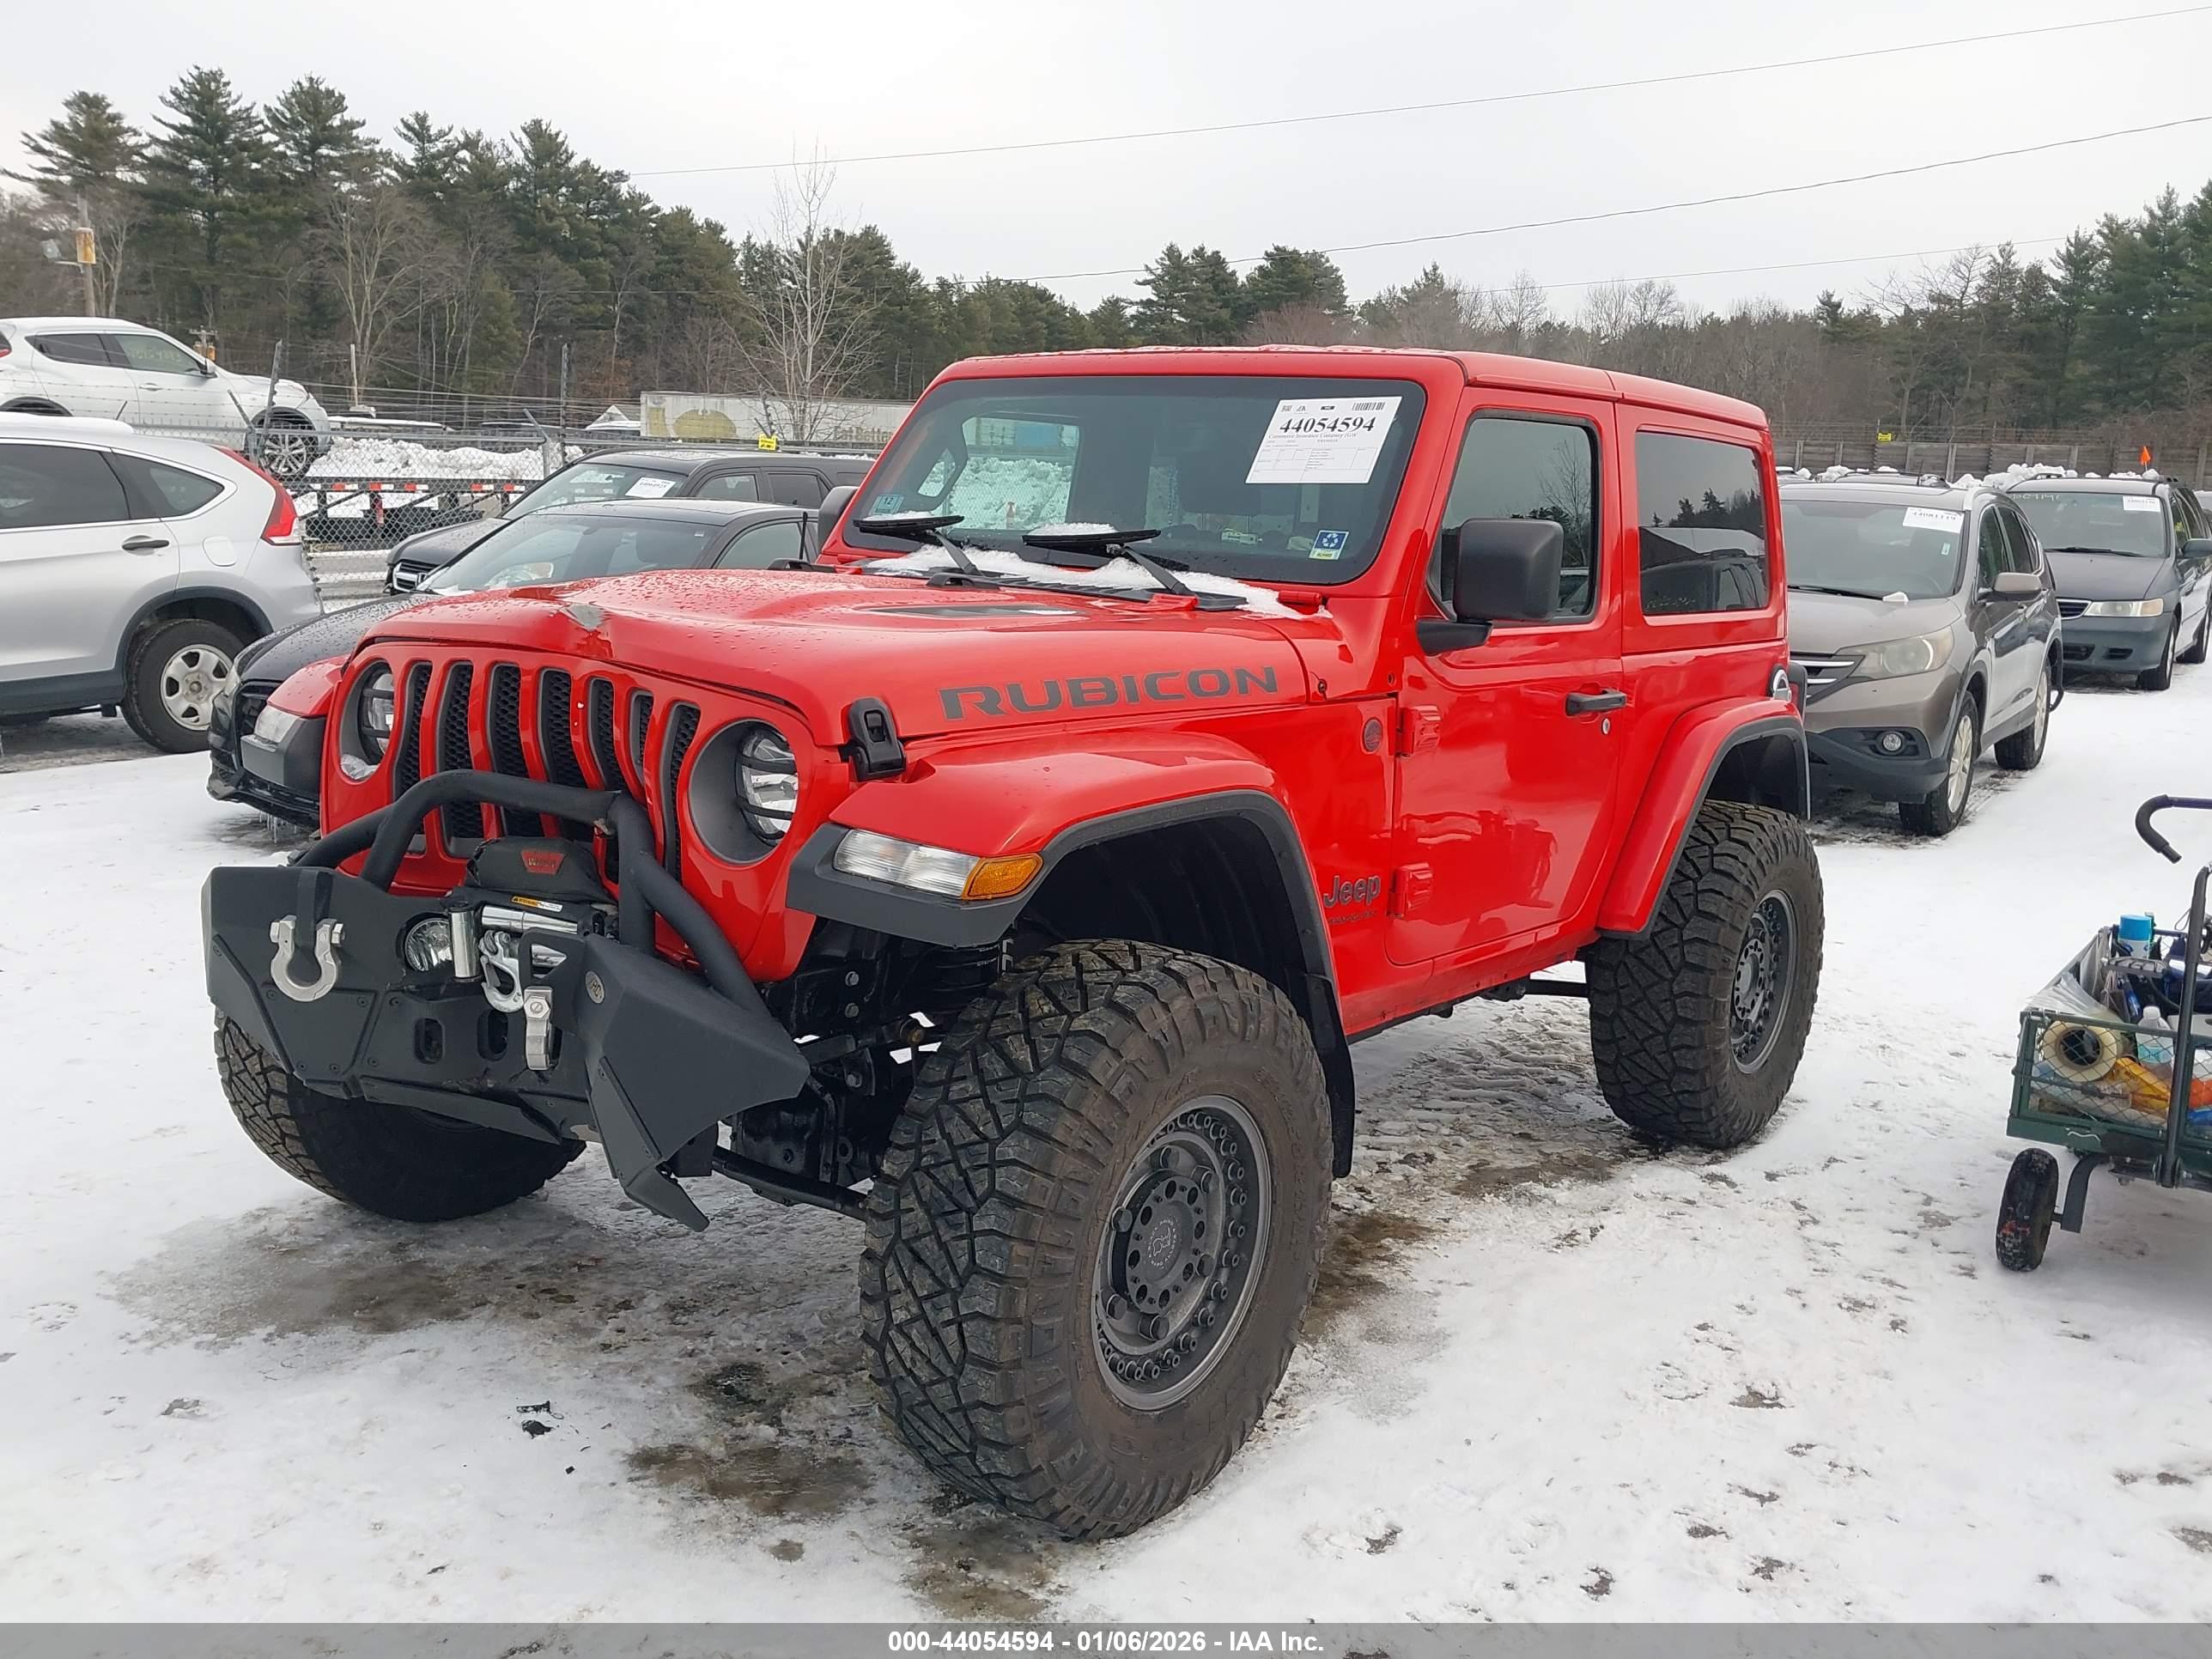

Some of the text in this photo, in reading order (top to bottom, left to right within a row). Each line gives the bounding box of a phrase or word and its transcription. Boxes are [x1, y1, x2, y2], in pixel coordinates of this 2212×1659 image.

[1279, 416, 1376, 434] 44054594
[939, 665, 1279, 720] RUBICON
[1323, 875, 1382, 908] Jeep
